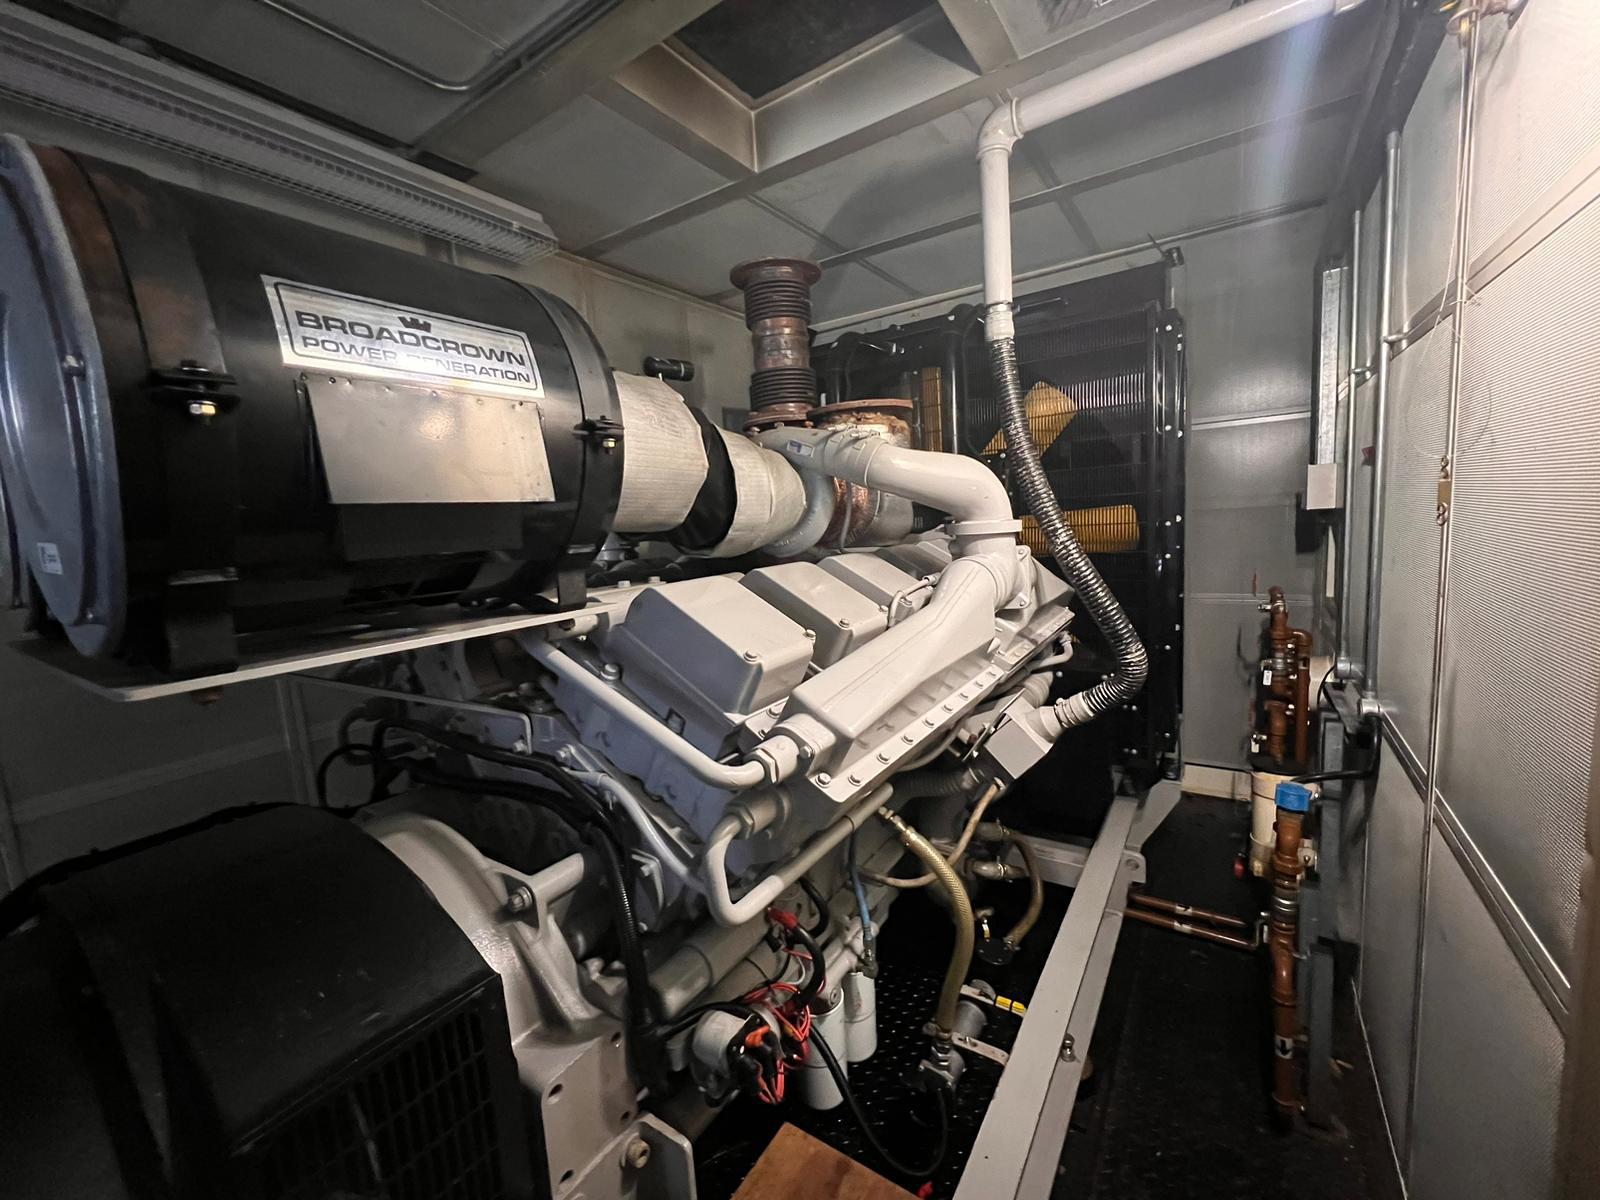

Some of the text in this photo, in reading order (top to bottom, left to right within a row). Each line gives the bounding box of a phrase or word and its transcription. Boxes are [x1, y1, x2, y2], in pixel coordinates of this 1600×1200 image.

[295, 311, 526, 367] BROADCROWN
[301, 335, 531, 384] POWER NERATION
